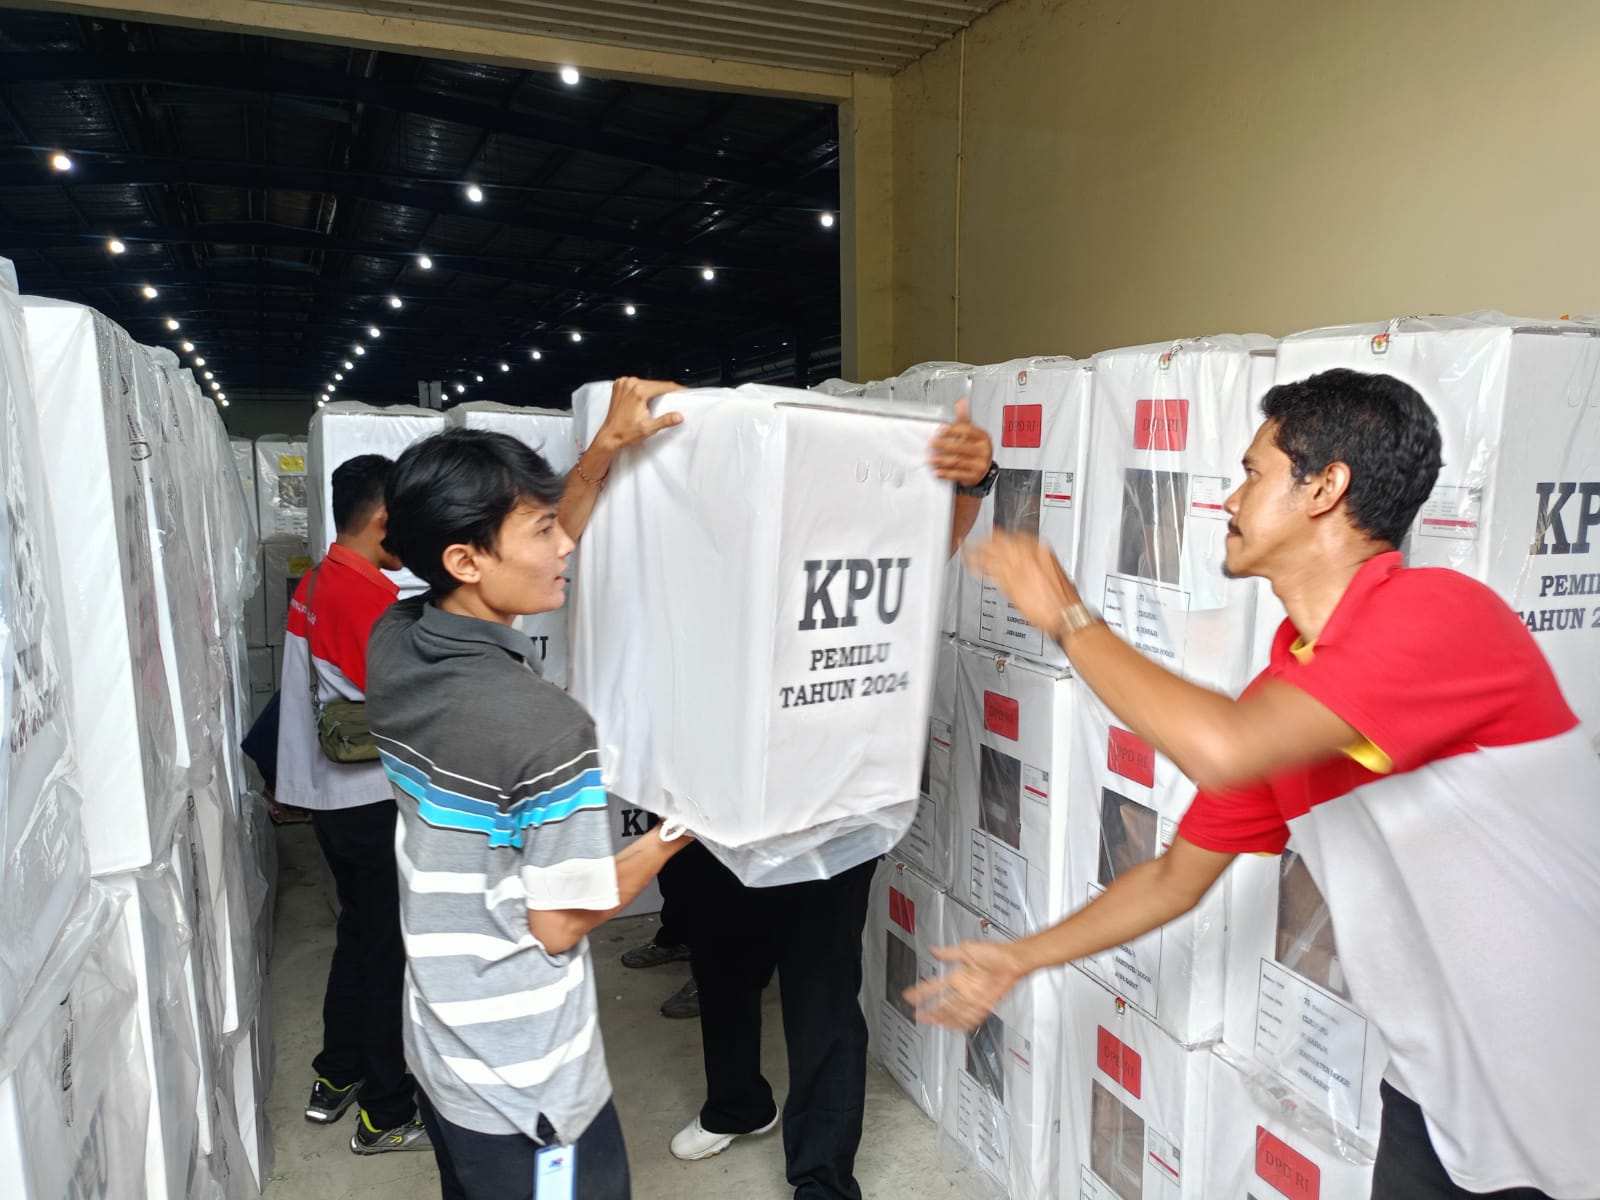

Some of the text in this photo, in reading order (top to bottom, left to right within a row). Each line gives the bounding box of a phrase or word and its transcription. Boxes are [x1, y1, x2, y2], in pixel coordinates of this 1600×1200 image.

[798, 557, 912, 631] KPU
[1539, 573, 1600, 597] PEMI
[809, 642, 891, 671] PEMILU
[779, 671, 910, 709] TAHUN 2024
[1266, 1150, 1309, 1192] DPD RI
